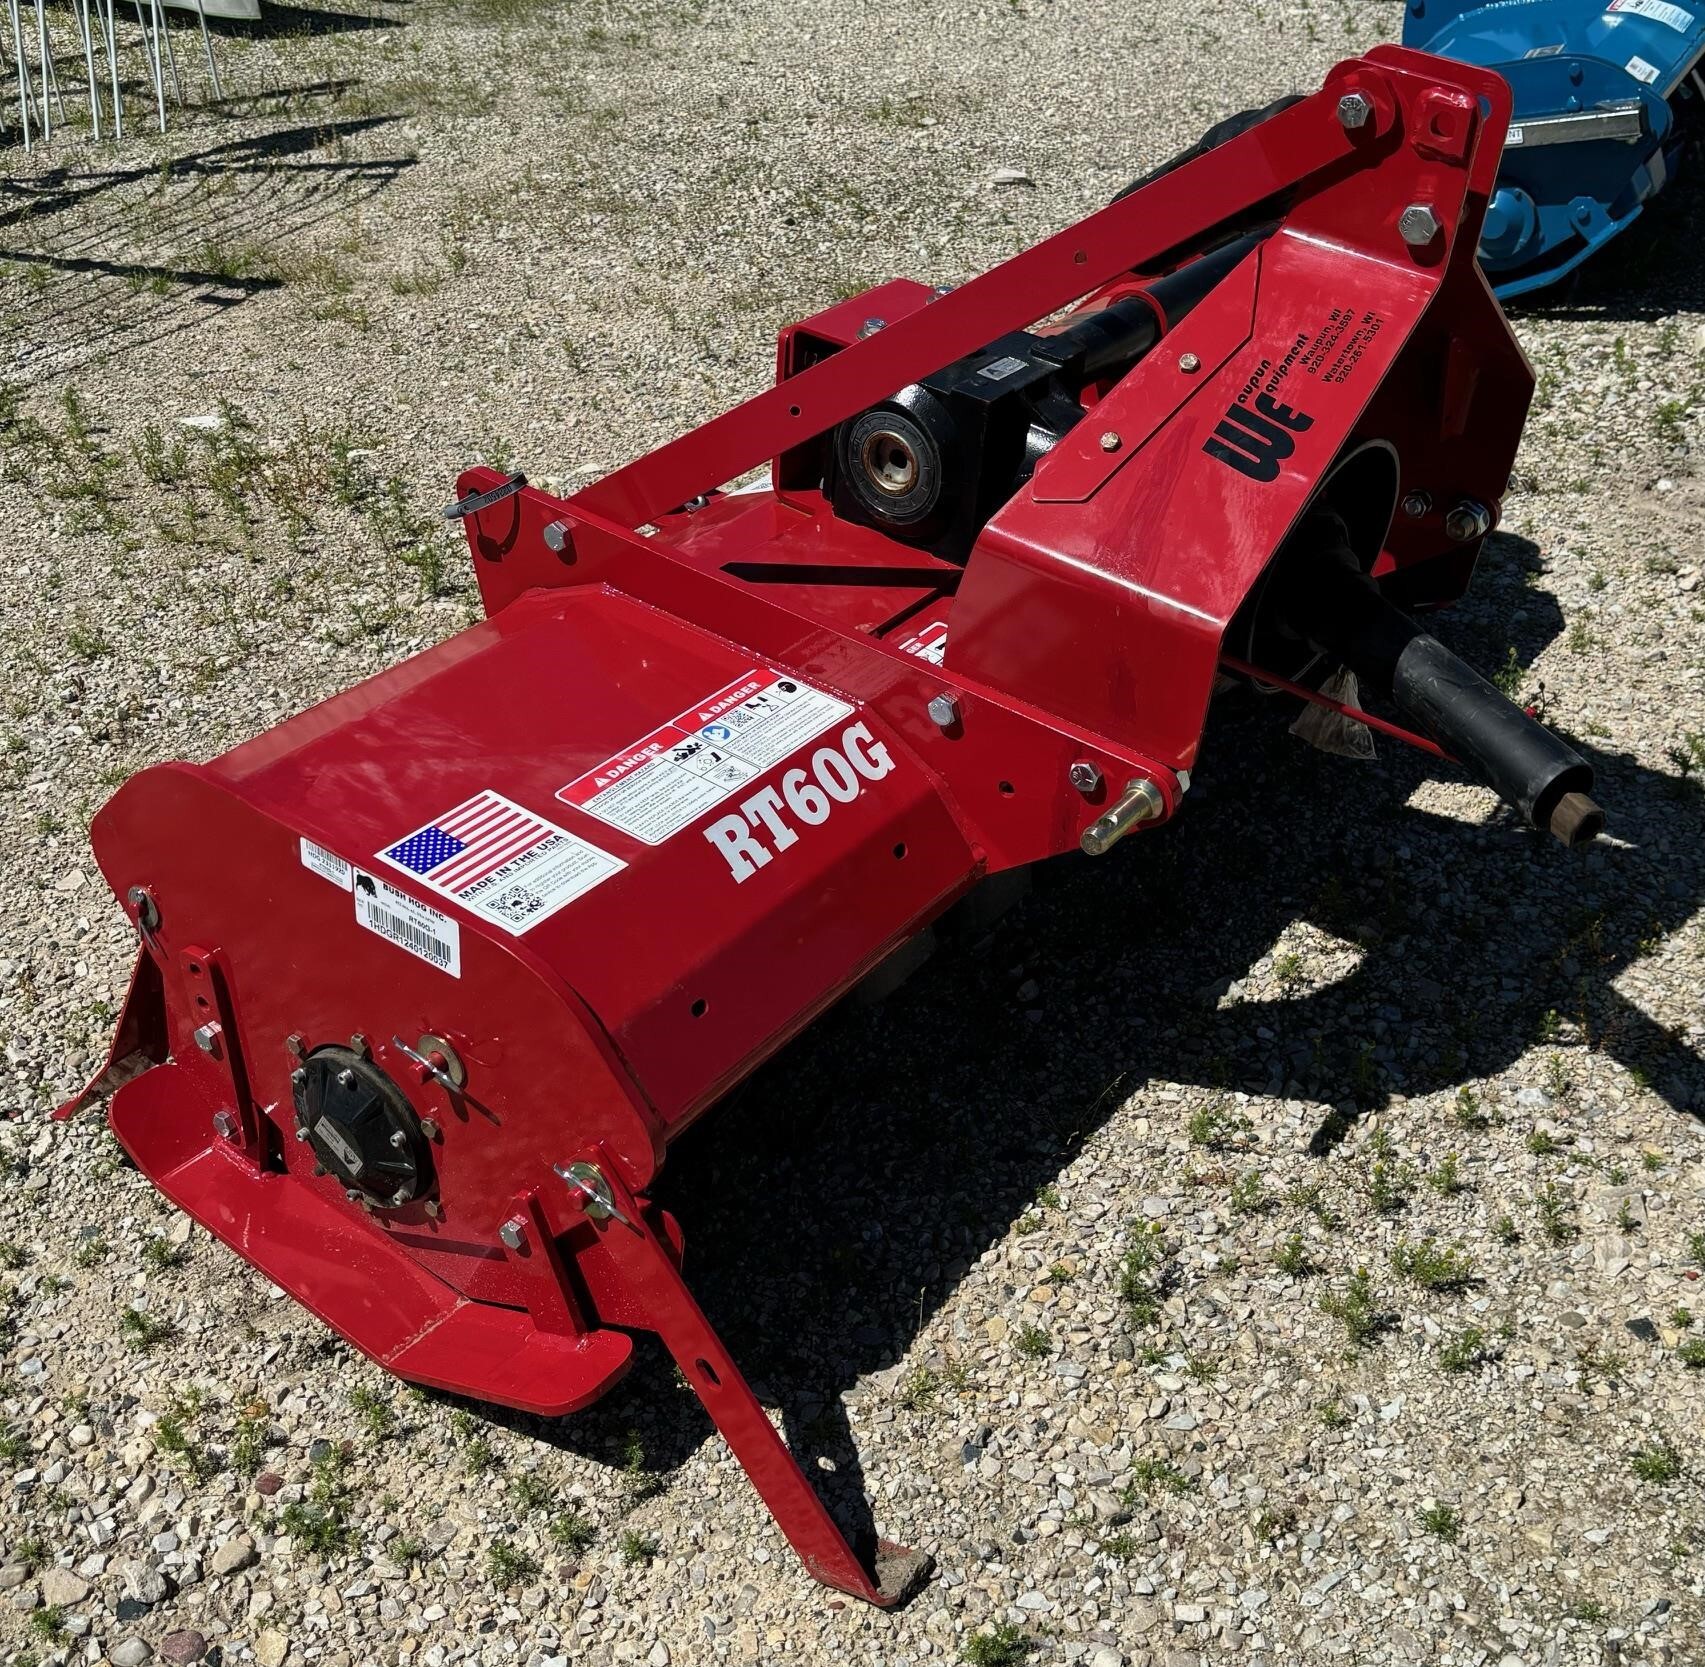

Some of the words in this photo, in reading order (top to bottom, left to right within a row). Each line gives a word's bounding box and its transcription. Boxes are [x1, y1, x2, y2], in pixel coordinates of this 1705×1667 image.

[1299, 325, 1334, 364] Waupun,
[1329, 309, 1341, 321] WI
[1307, 308, 1355, 374] 920-324-3597
[1321, 328, 1367, 382] Watertown,
[1361, 311, 1376, 324] WI
[1335, 318, 1384, 383] 920-261-5301
[708, 681, 762, 713] DANGER
[606, 742, 664, 778] DANGER
[703, 721, 896, 884] RT60G
[458, 876, 496, 899] MADE
[495, 866, 512, 876] IN
[510, 850, 539, 867] THE
[537, 835, 564, 851] USA
[468, 889, 485, 901] WITH
[499, 871, 514, 882] AND
[514, 851, 547, 873] IMPORTED
[548, 837, 569, 852] PARTS
[383, 883, 406, 900] BUSH
[408, 897, 427, 912] HOG
[429, 907, 447, 923] INC.
